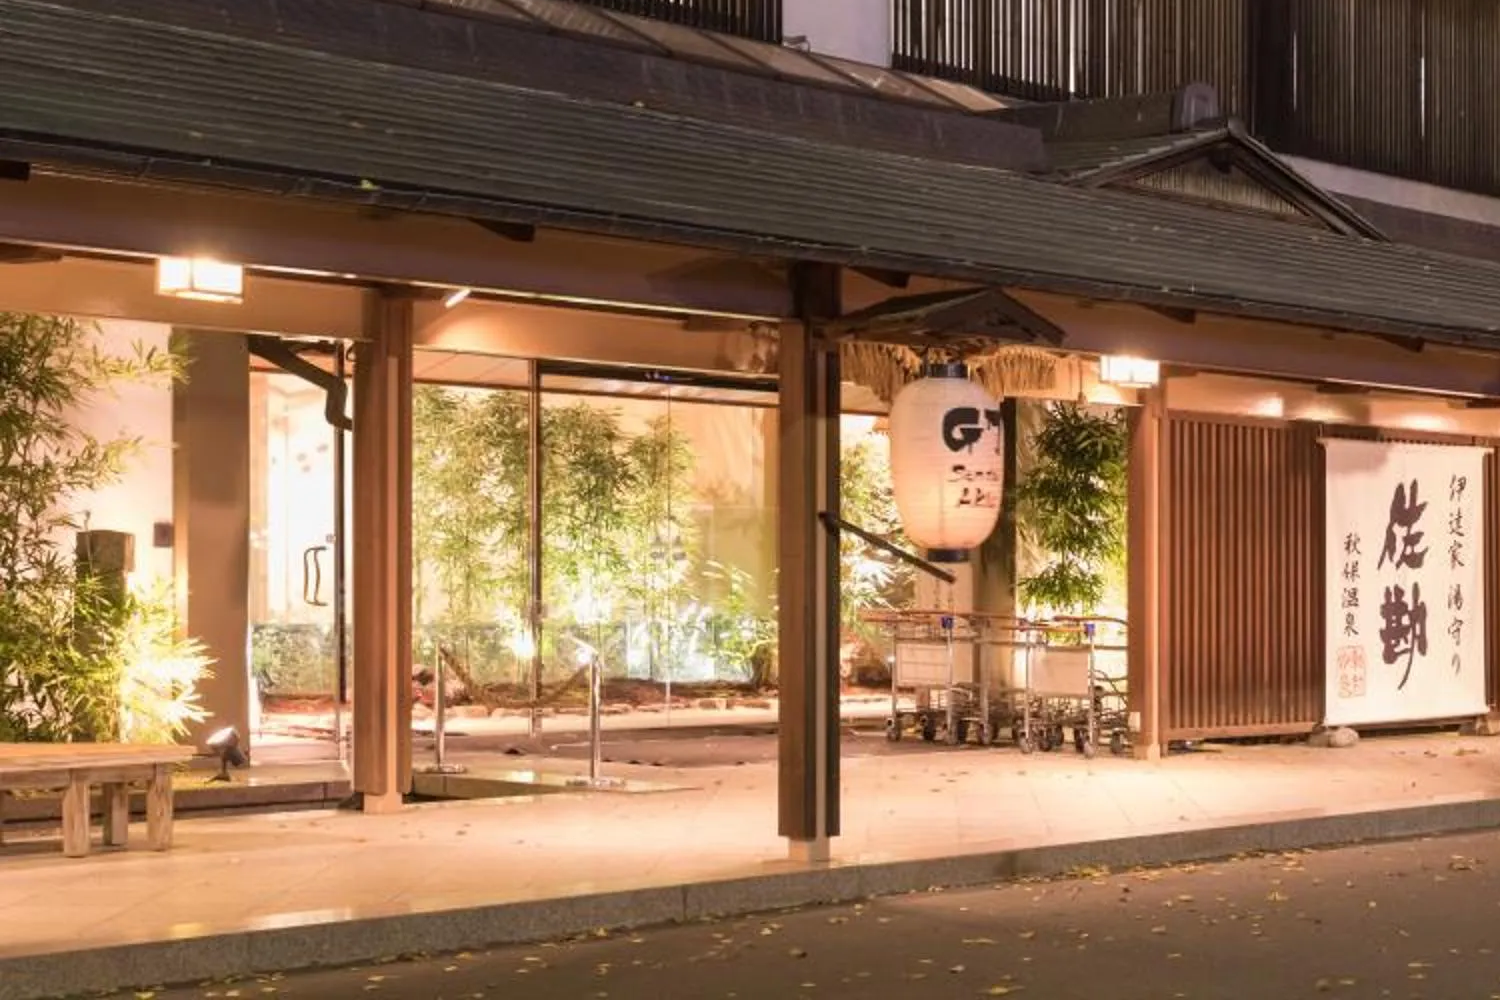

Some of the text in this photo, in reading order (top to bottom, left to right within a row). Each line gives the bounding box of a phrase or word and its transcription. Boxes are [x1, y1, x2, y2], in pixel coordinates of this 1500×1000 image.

[1341, 532, 1362, 637] 秋保温泉
[1376, 477, 1429, 691] 佐勘
